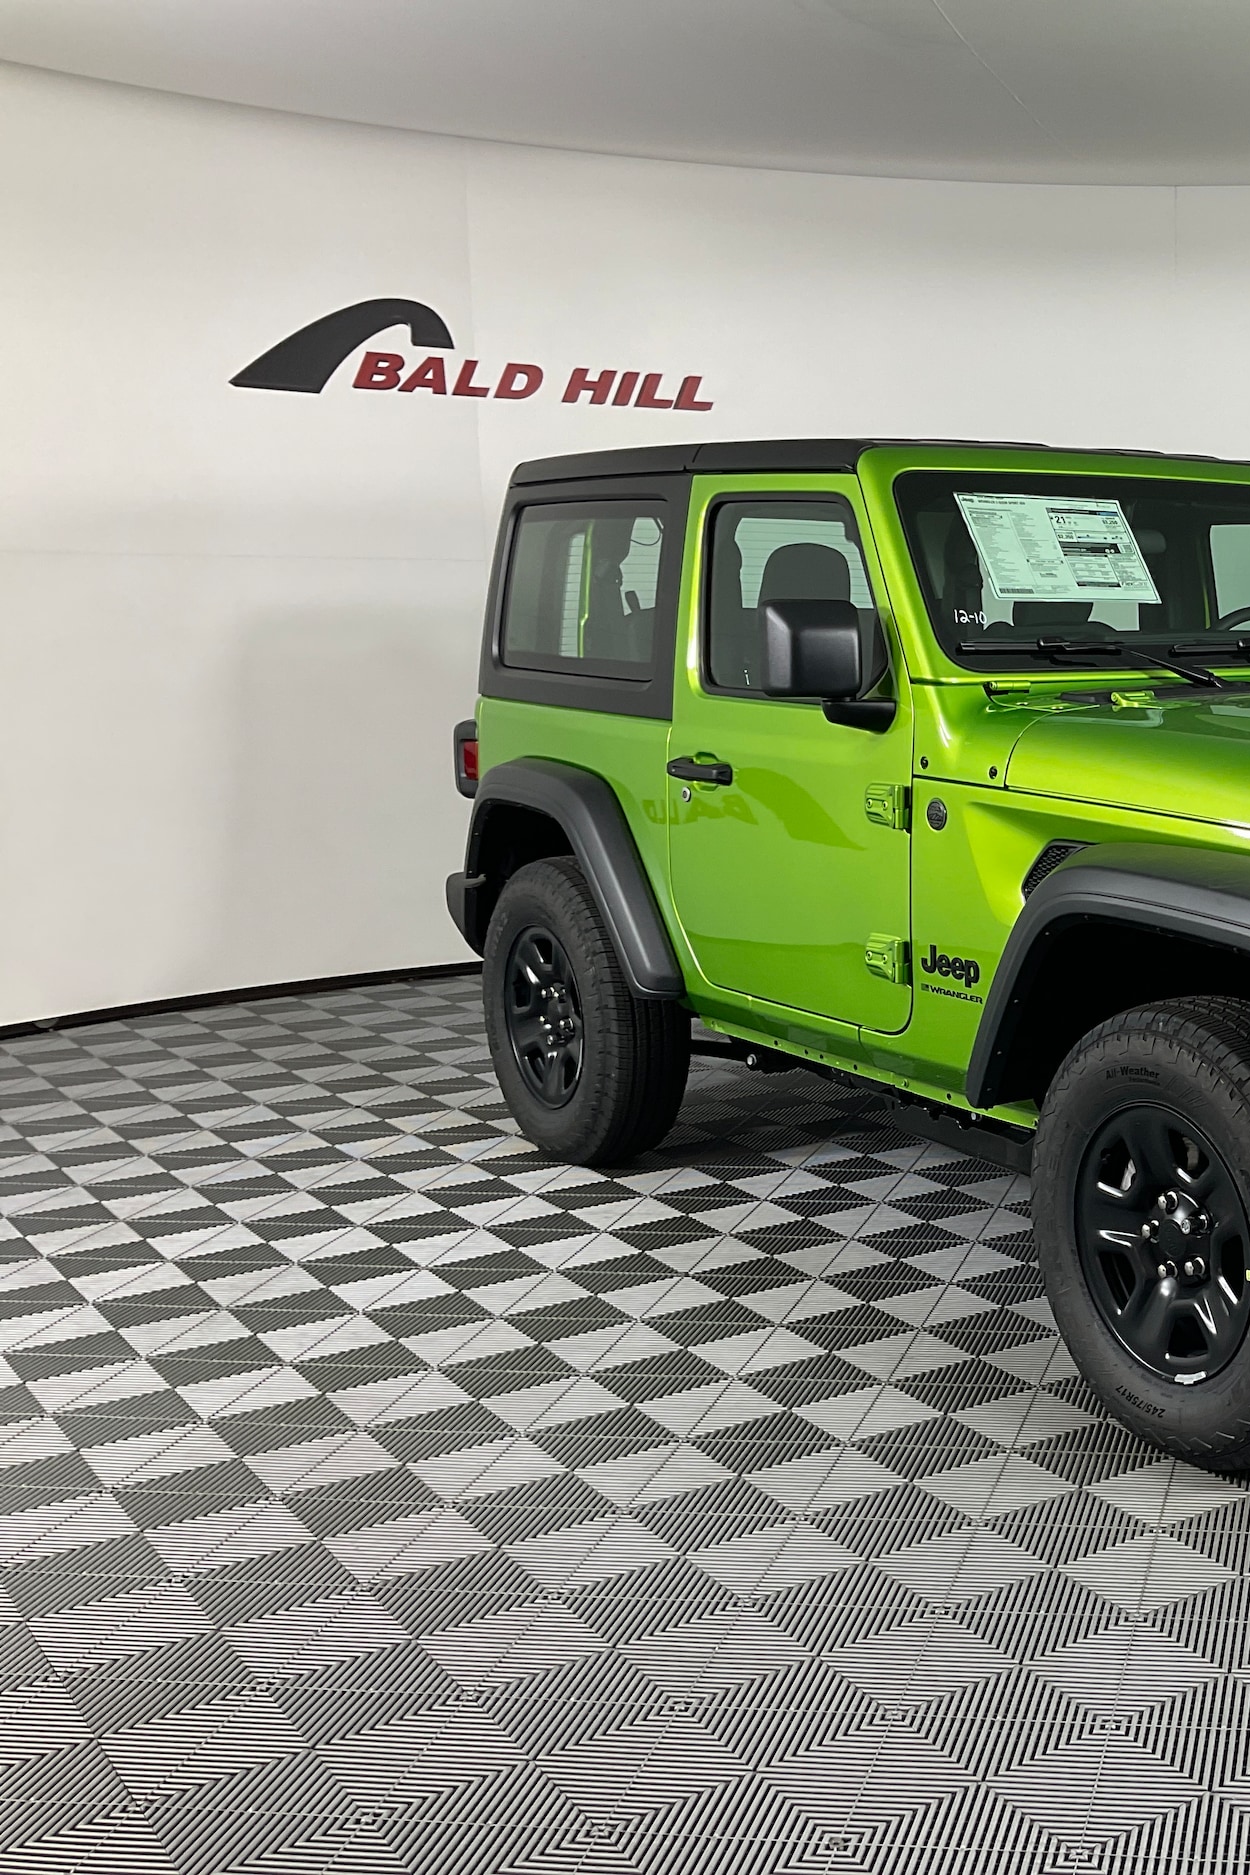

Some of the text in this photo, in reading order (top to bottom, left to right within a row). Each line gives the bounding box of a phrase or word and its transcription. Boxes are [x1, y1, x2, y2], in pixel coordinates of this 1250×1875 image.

[352, 351, 714, 411] BALD HILL
[954, 609, 987, 624] 12-10
[921, 944, 980, 988] Jeep
[929, 985, 983, 1004] WRANGLER
[1106, 1066, 1160, 1080] All-Weather
[1115, 1385, 1166, 1418] 245/75R17
